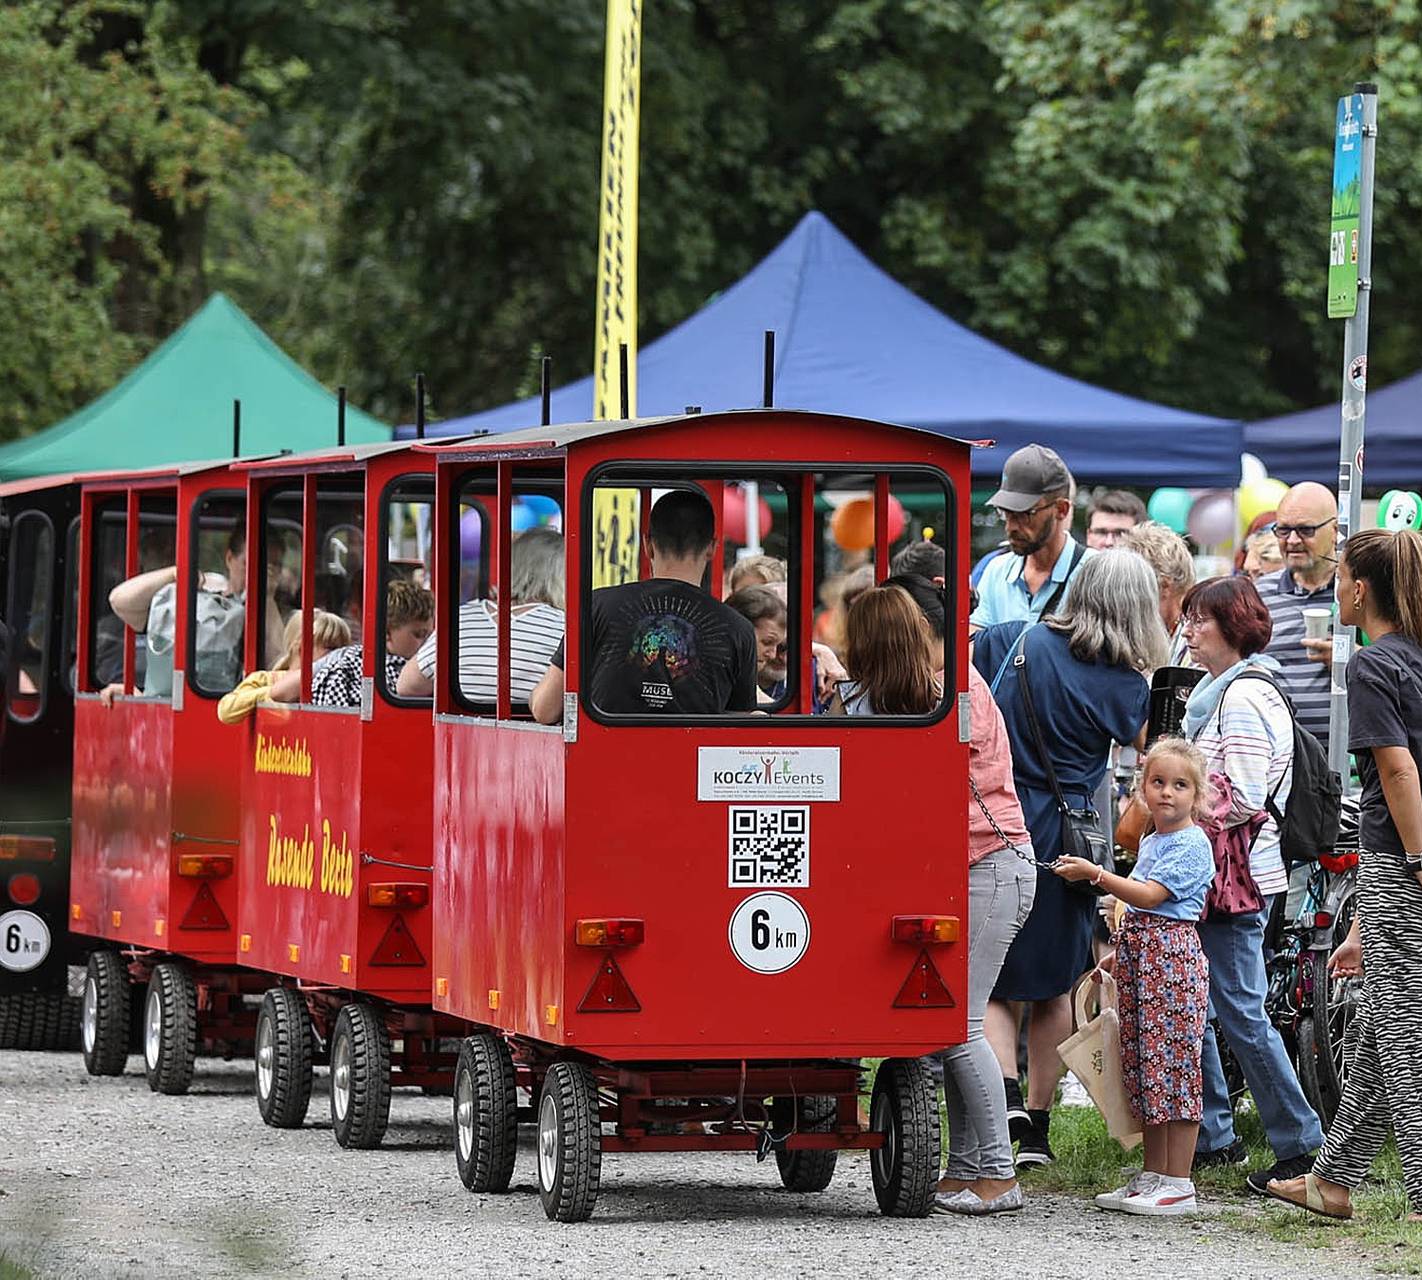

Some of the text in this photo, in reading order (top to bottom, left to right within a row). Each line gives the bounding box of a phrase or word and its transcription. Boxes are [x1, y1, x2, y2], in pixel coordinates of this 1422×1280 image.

[713, 771, 825, 785] KOCZY Events
[266, 814, 353, 899] Rasende Berta
[7, 924, 21, 953] 6
[751, 909, 797, 951] 6 km
